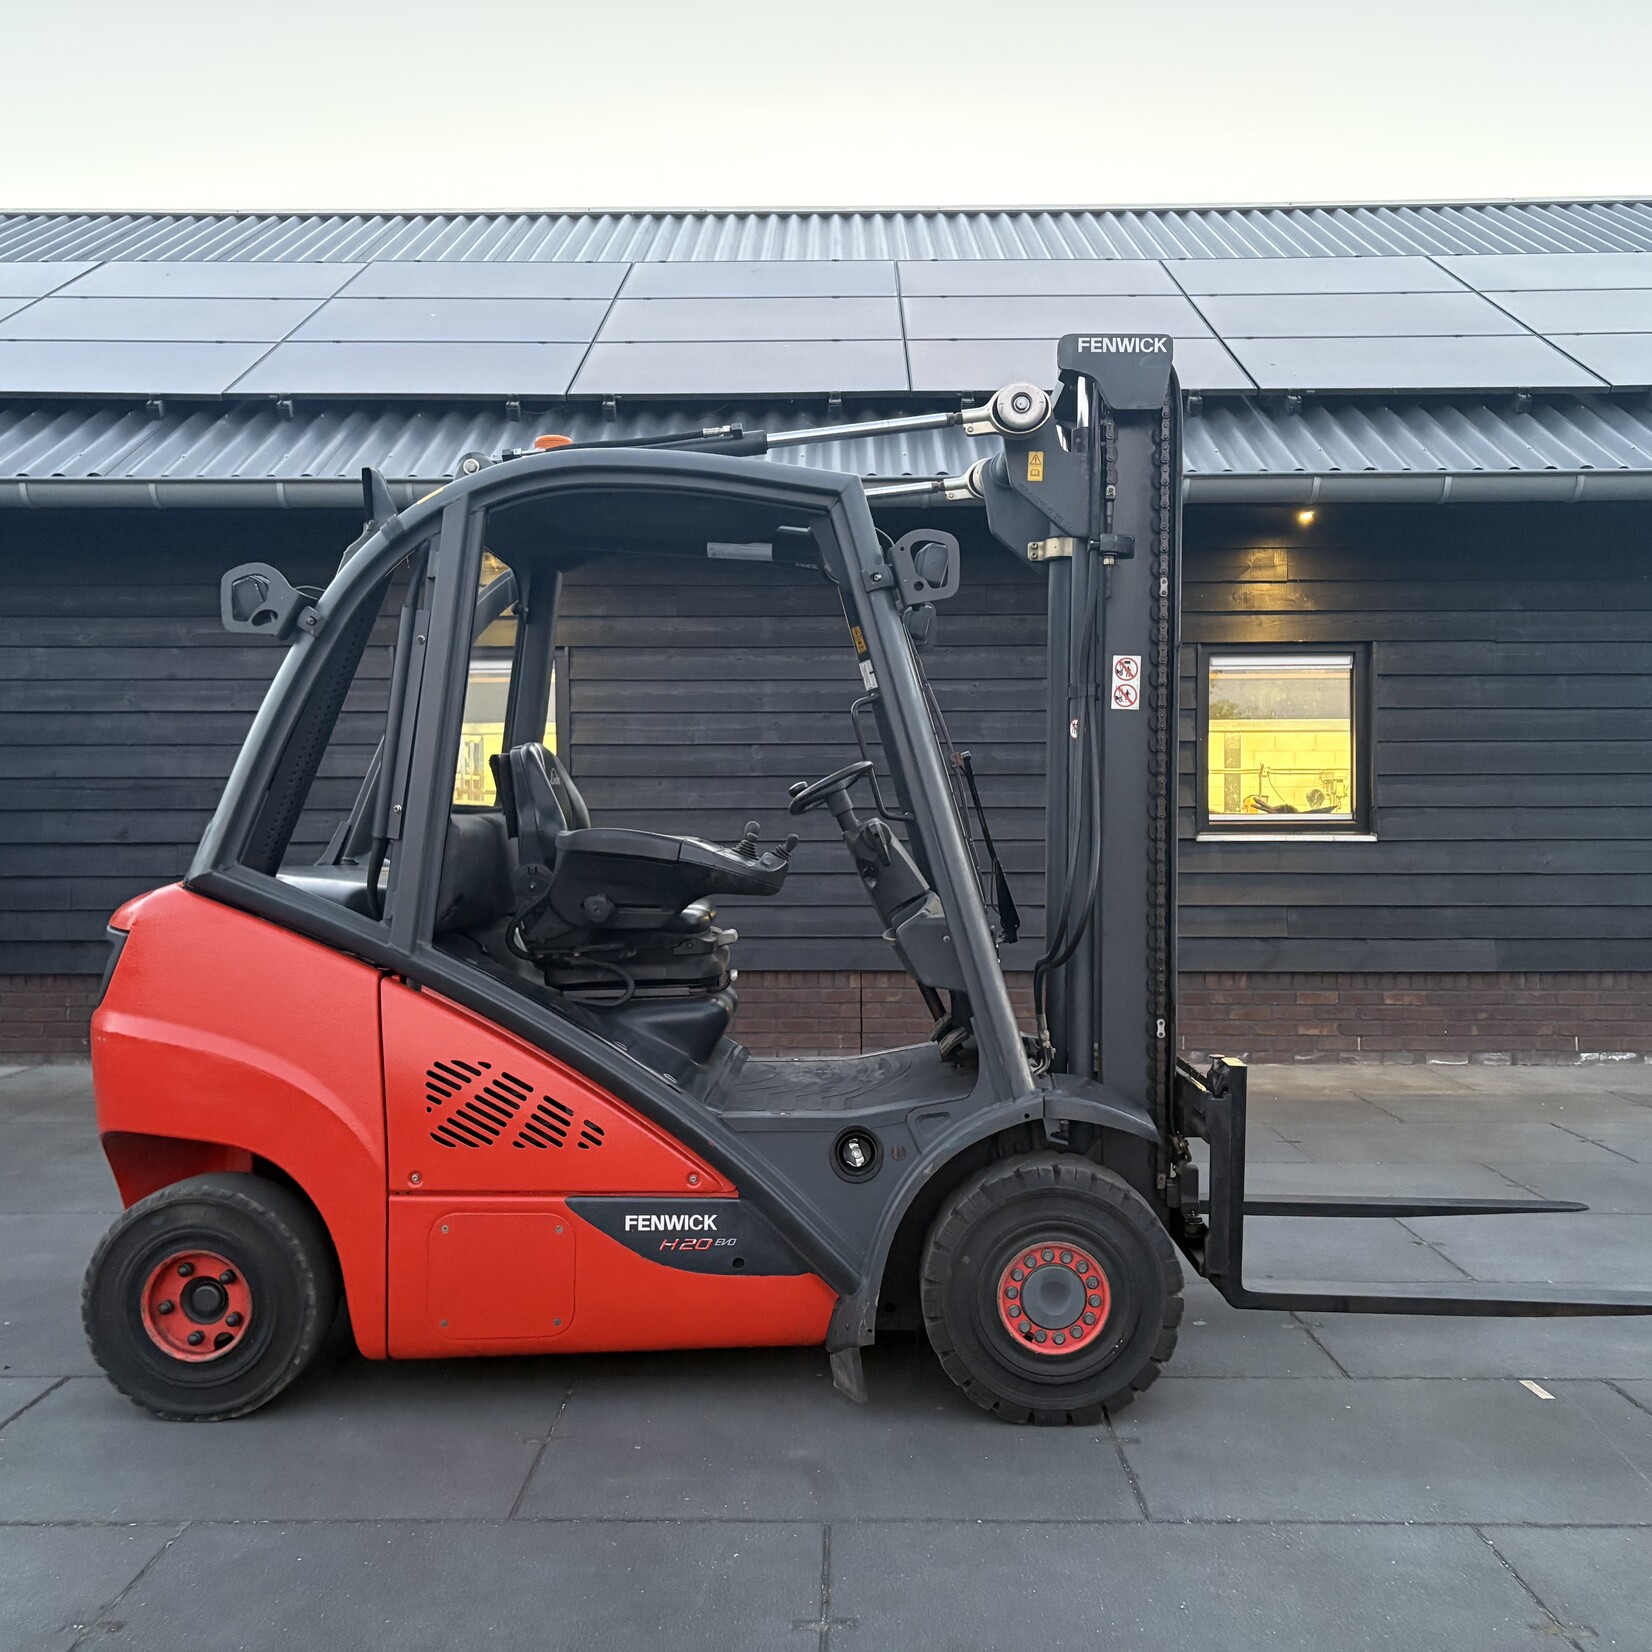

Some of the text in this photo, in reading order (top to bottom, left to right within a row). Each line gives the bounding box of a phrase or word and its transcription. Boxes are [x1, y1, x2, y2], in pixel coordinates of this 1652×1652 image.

[1077, 337, 1168, 353] FENWICK
[624, 1214, 718, 1232] FENWICK
[714, 1238, 737, 1246] EVO
